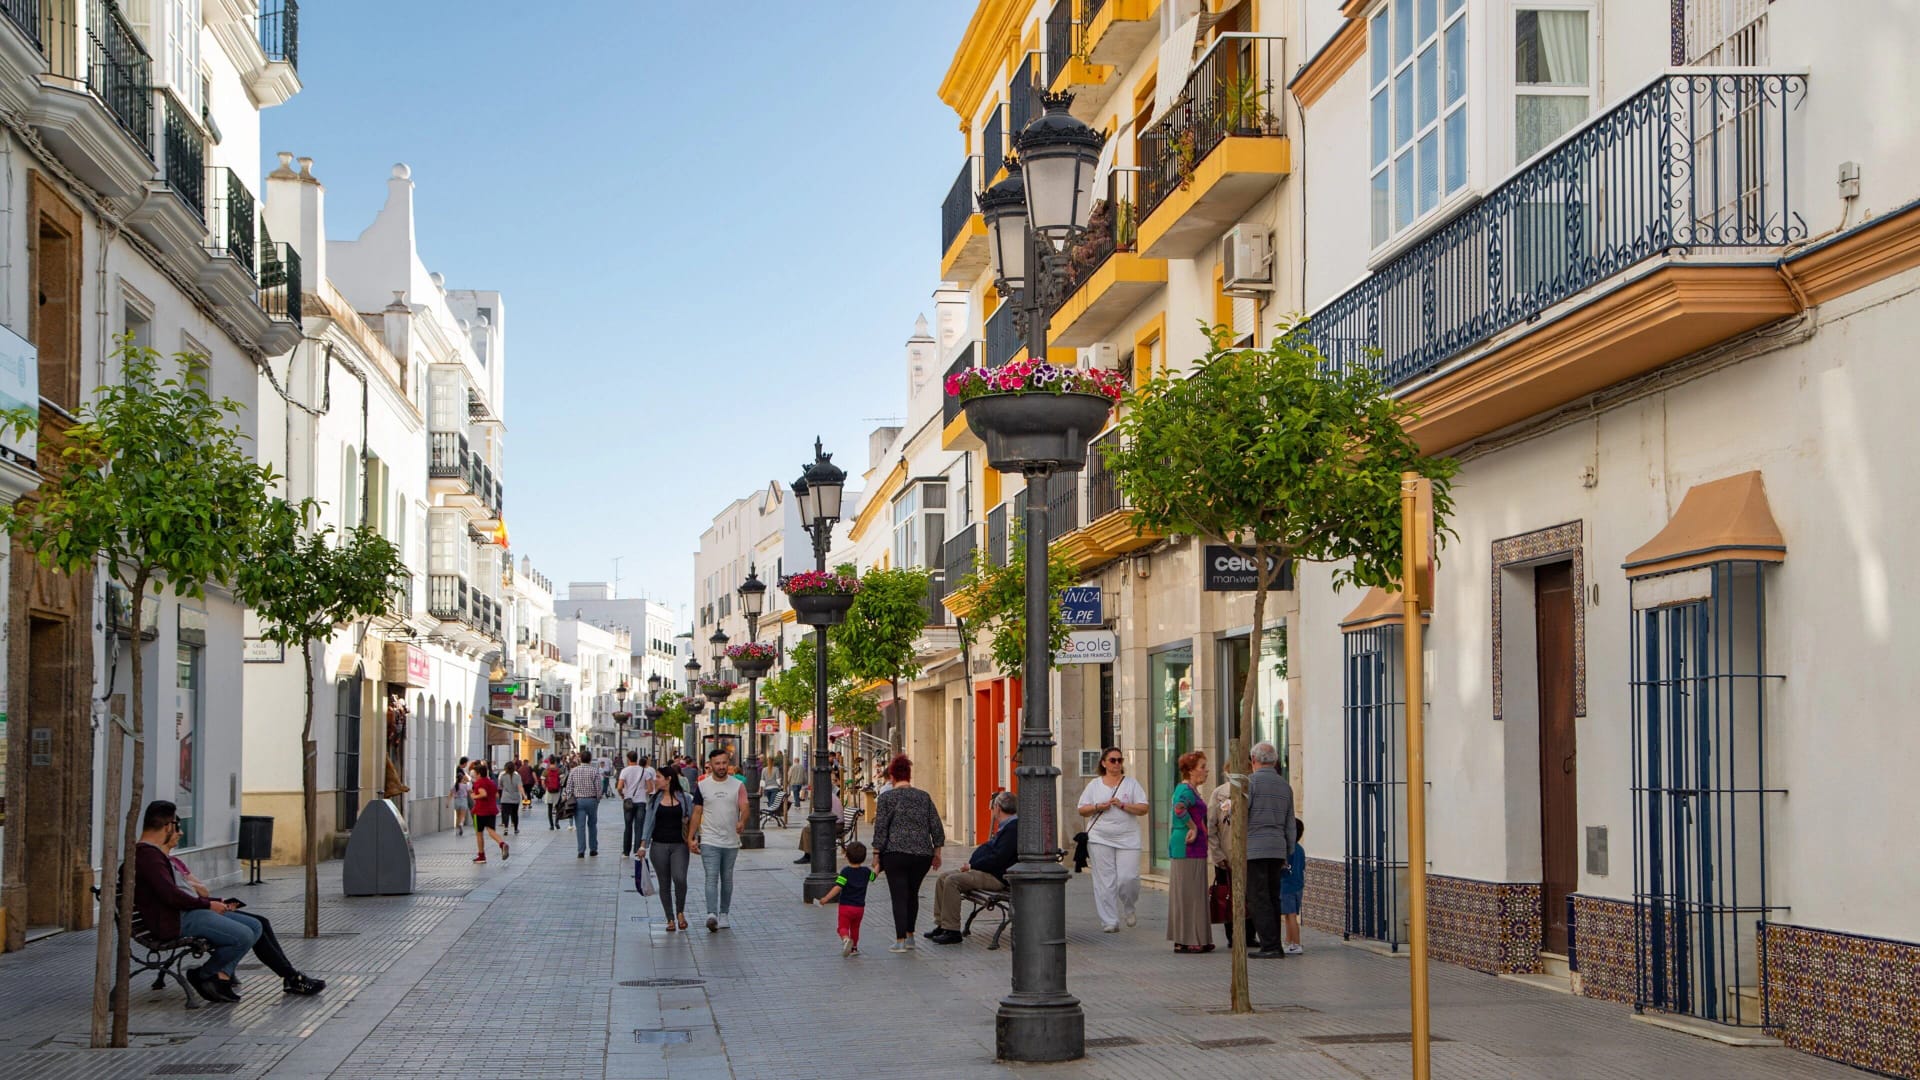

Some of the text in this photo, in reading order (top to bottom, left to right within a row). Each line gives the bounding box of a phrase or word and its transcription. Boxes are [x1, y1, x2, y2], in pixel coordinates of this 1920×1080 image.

[1586, 583, 1600, 607] 10
[1061, 610, 1094, 619] EL PIE
